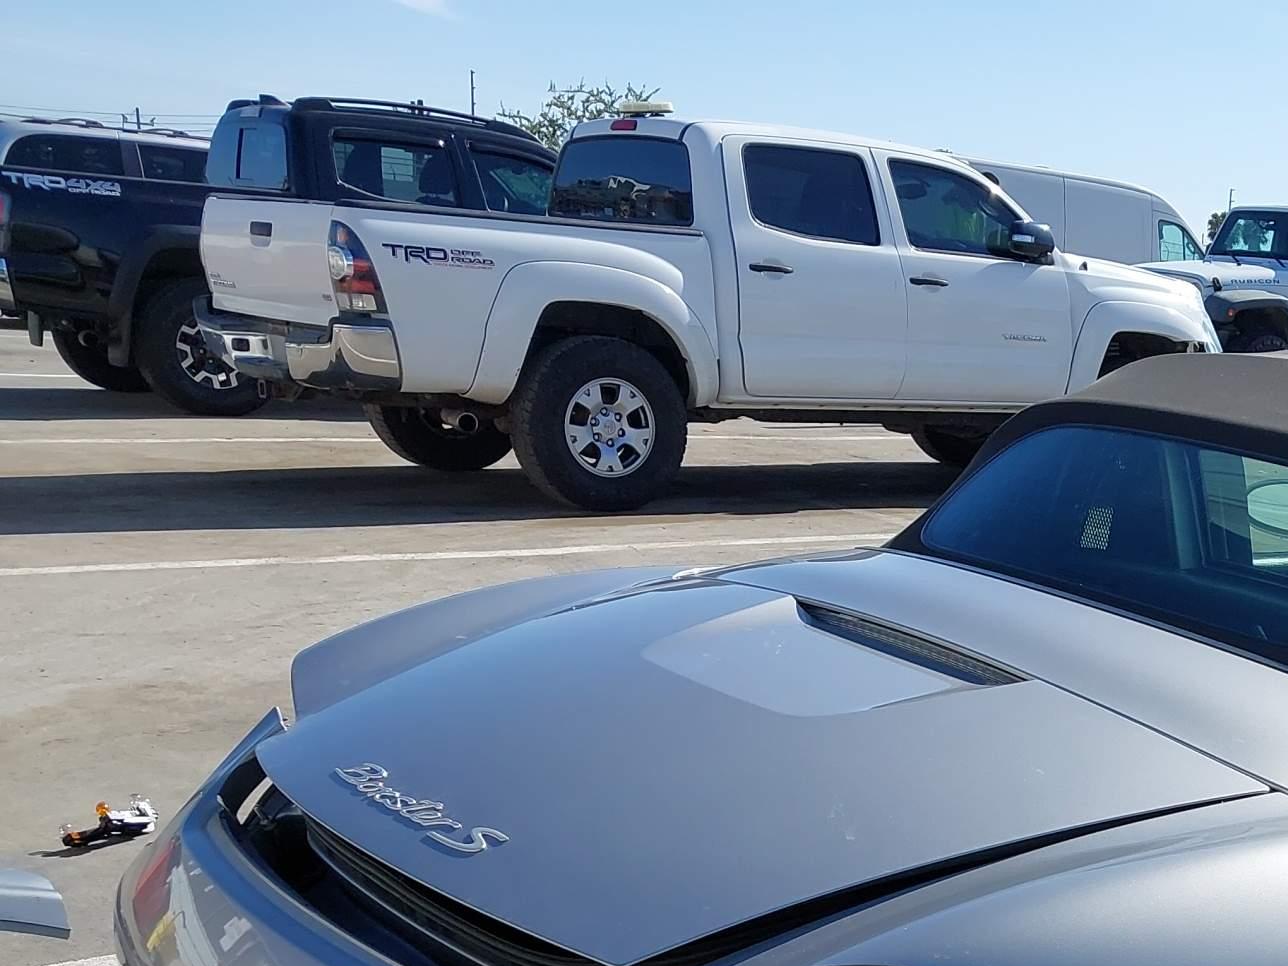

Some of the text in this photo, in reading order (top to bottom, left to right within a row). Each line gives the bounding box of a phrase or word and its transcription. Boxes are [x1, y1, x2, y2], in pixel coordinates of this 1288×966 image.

[1, 171, 66, 190] TRD
[382, 243, 448, 265] TRD
[451, 249, 481, 257] OFF
[451, 257, 495, 266] ROAD
[335, 763, 510, 853] Boxster S
